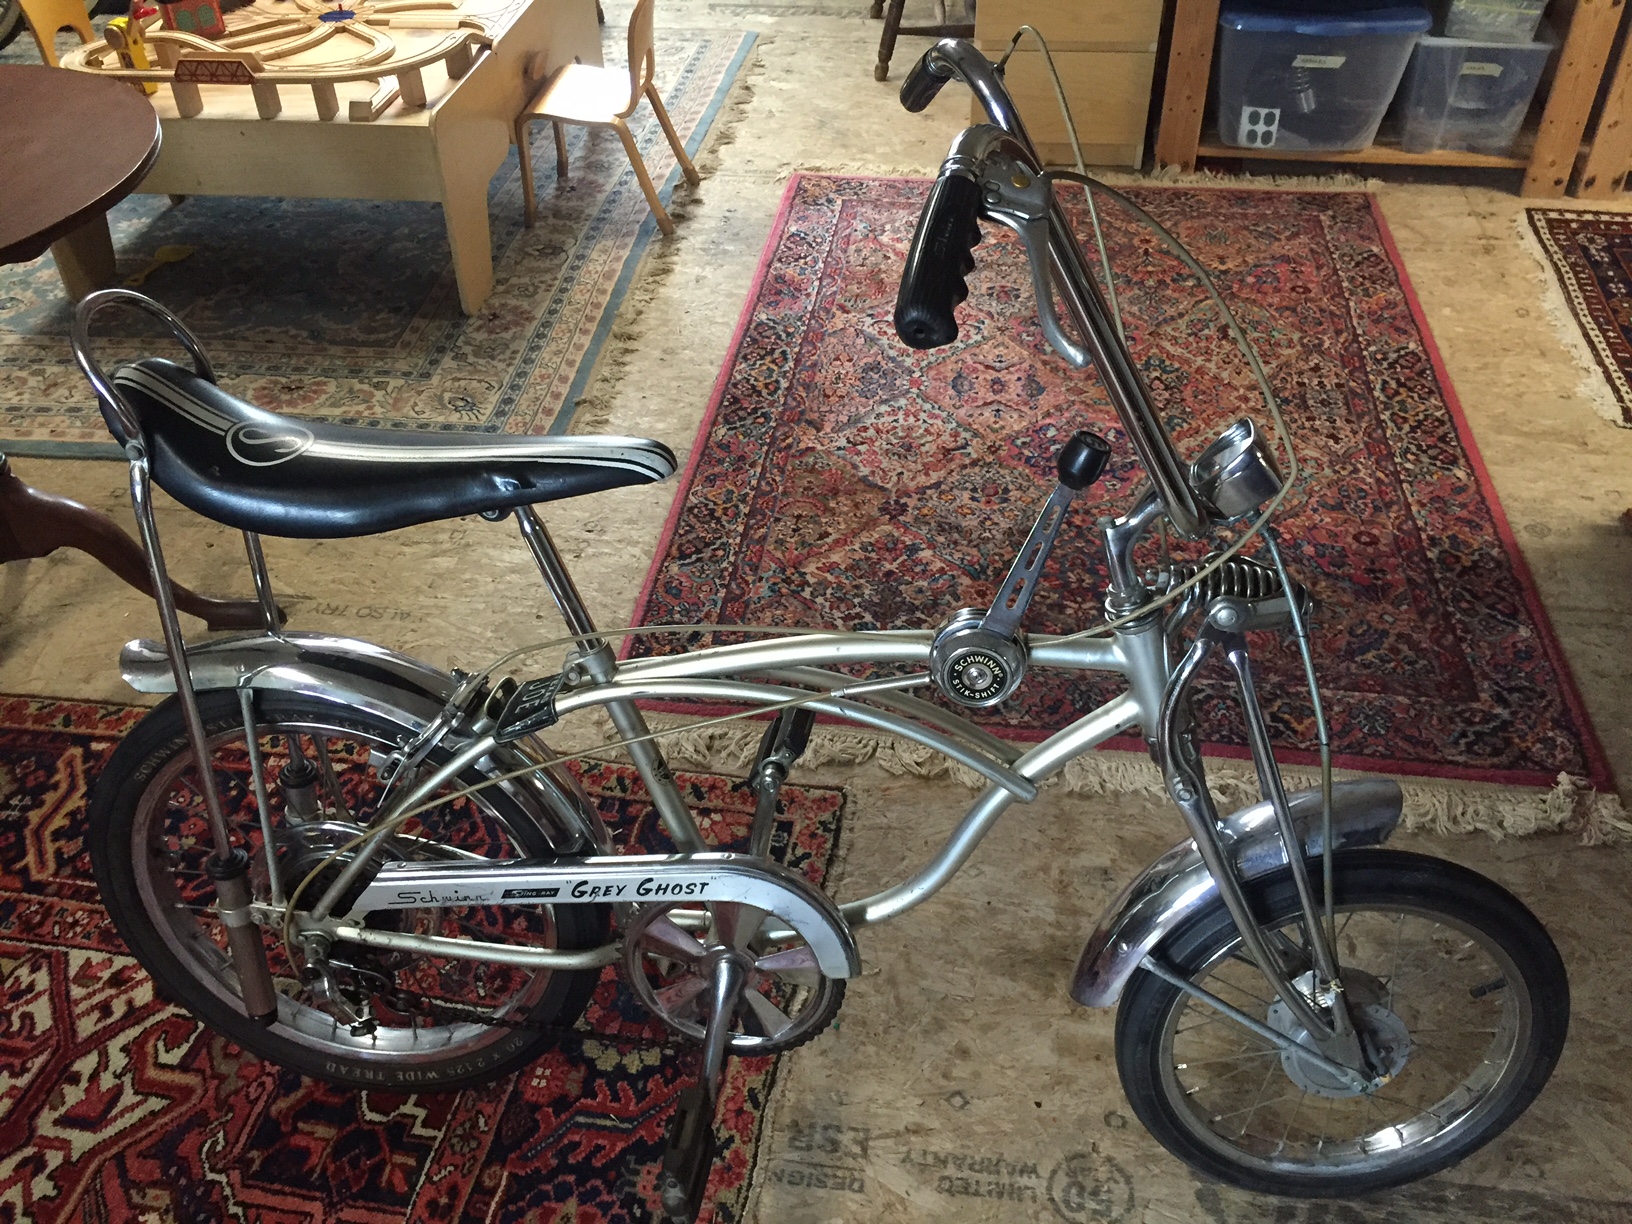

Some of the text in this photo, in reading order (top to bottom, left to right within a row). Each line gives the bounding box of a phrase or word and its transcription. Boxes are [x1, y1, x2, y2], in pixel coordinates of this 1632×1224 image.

[952, 679, 999, 699] STIK-SHIFT
[133, 733, 190, 782] SCHWIN
[325, 1061, 385, 1081] TREAD
[393, 1070, 439, 1082] WIDE
